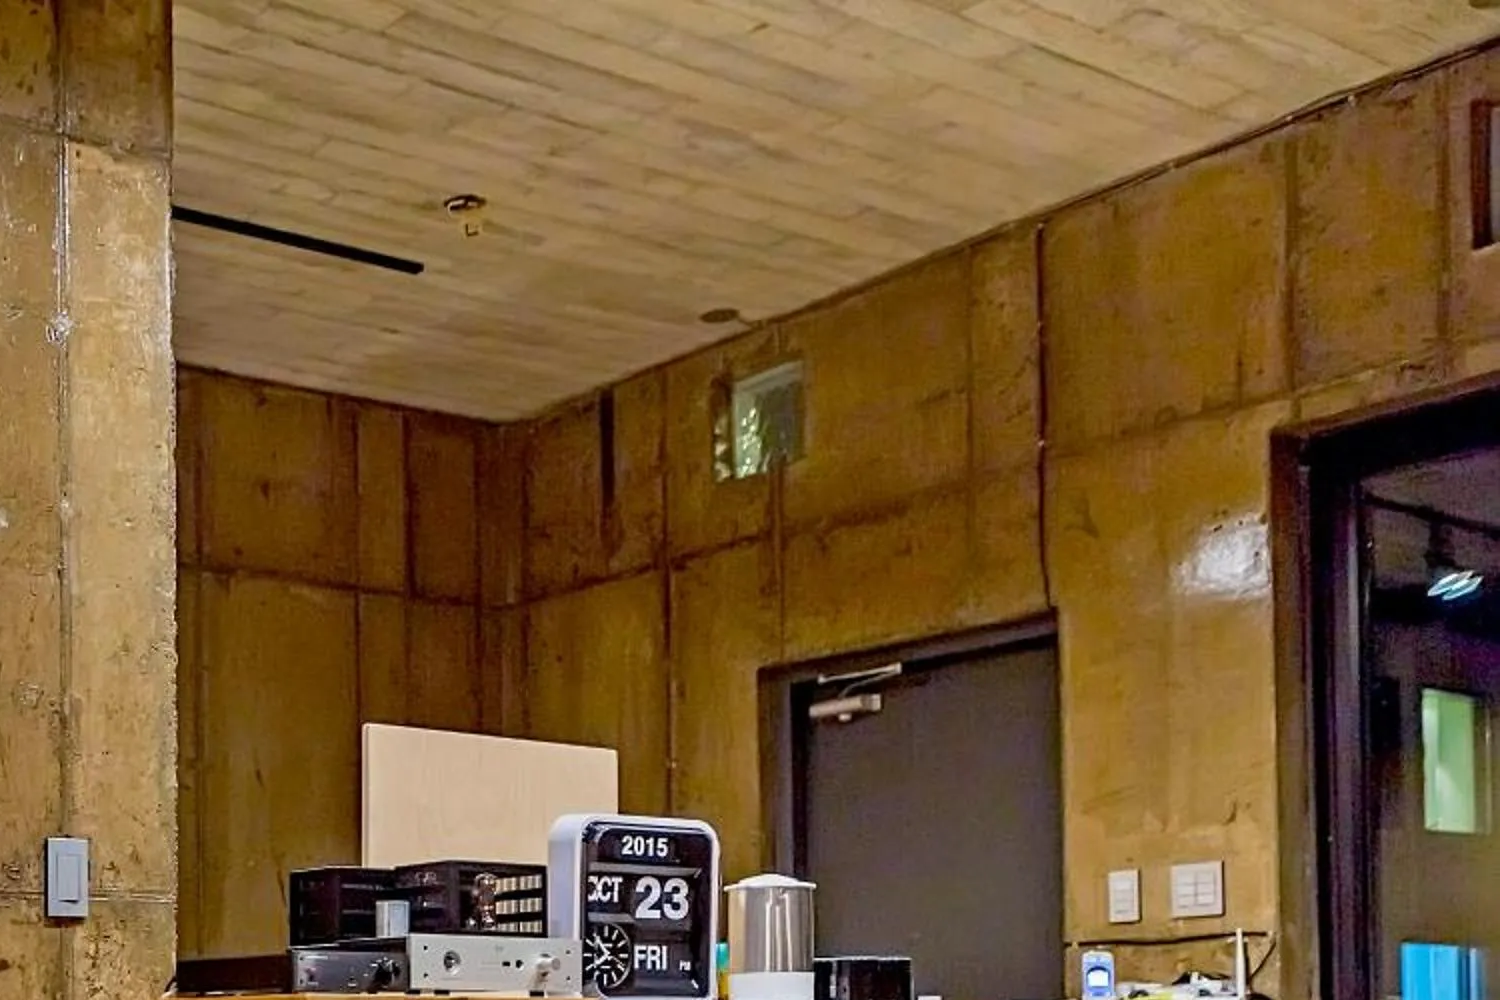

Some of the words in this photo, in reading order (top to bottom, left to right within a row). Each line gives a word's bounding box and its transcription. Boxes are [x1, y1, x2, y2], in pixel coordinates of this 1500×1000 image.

[621, 836, 669, 857] 2015
[635, 876, 690, 920] 23
[633, 945, 668, 971] FRI
